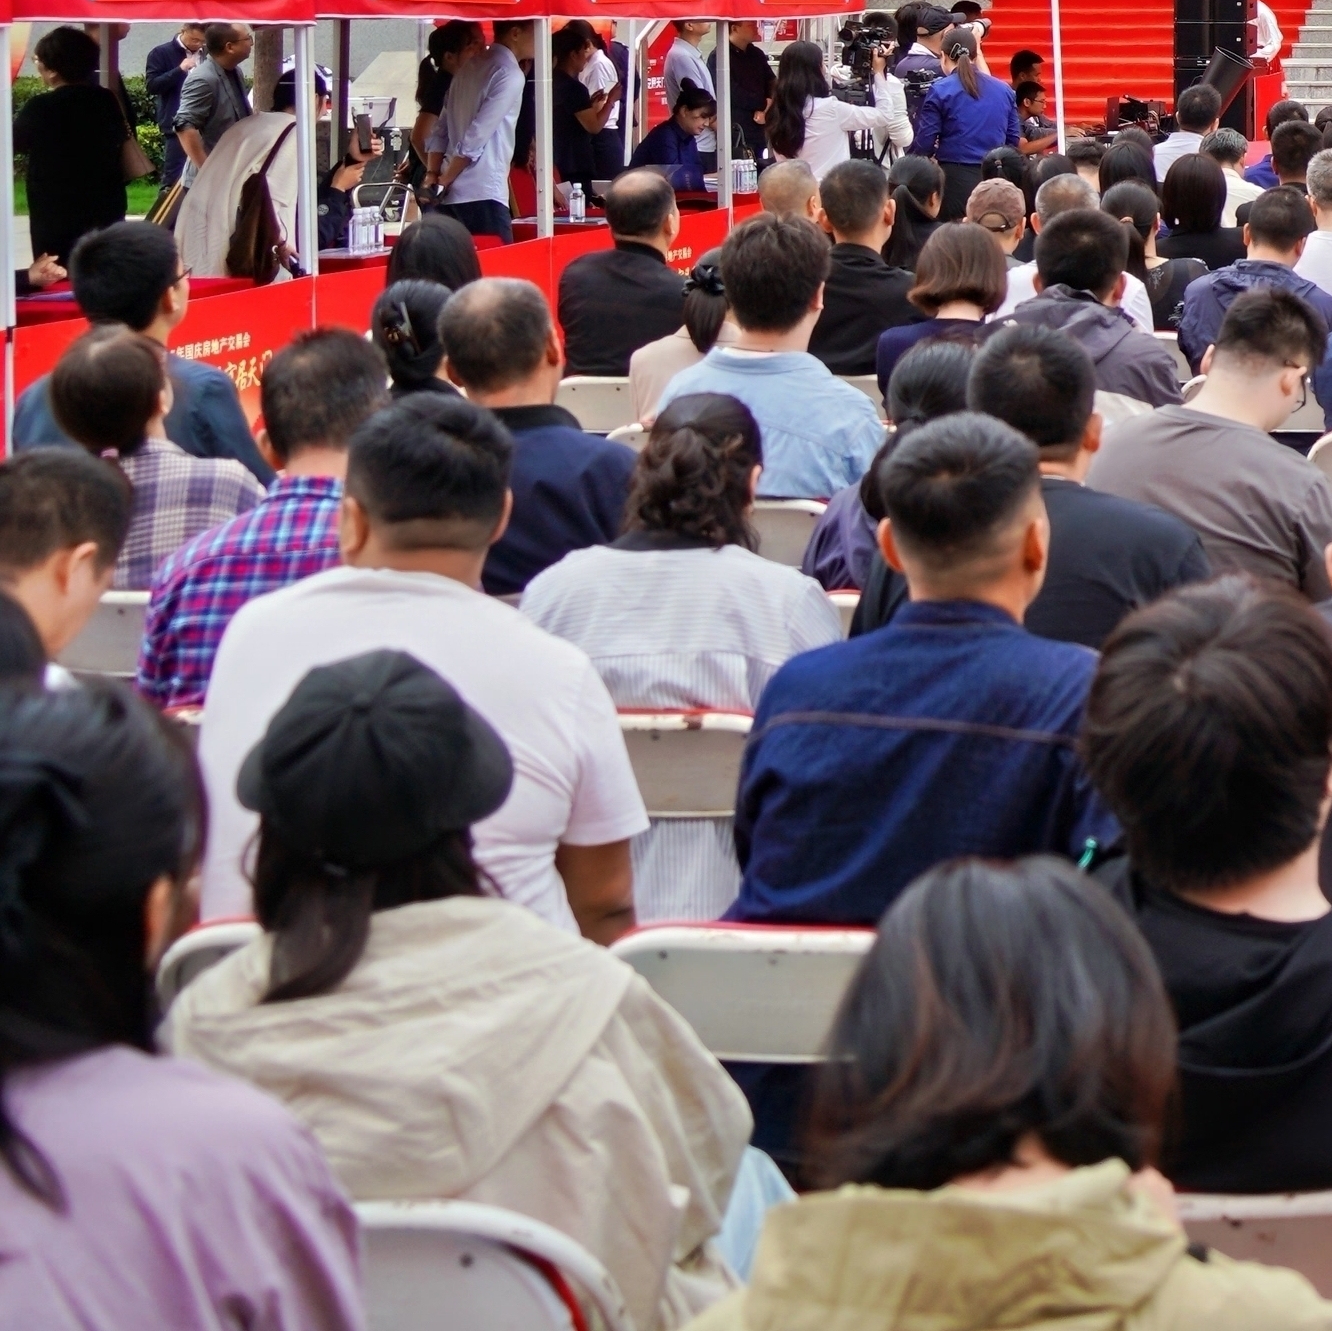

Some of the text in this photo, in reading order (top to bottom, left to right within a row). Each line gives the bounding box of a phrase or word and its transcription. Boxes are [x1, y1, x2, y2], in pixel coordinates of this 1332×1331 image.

[170, 332, 251, 360] 年国庆房地产交易会
